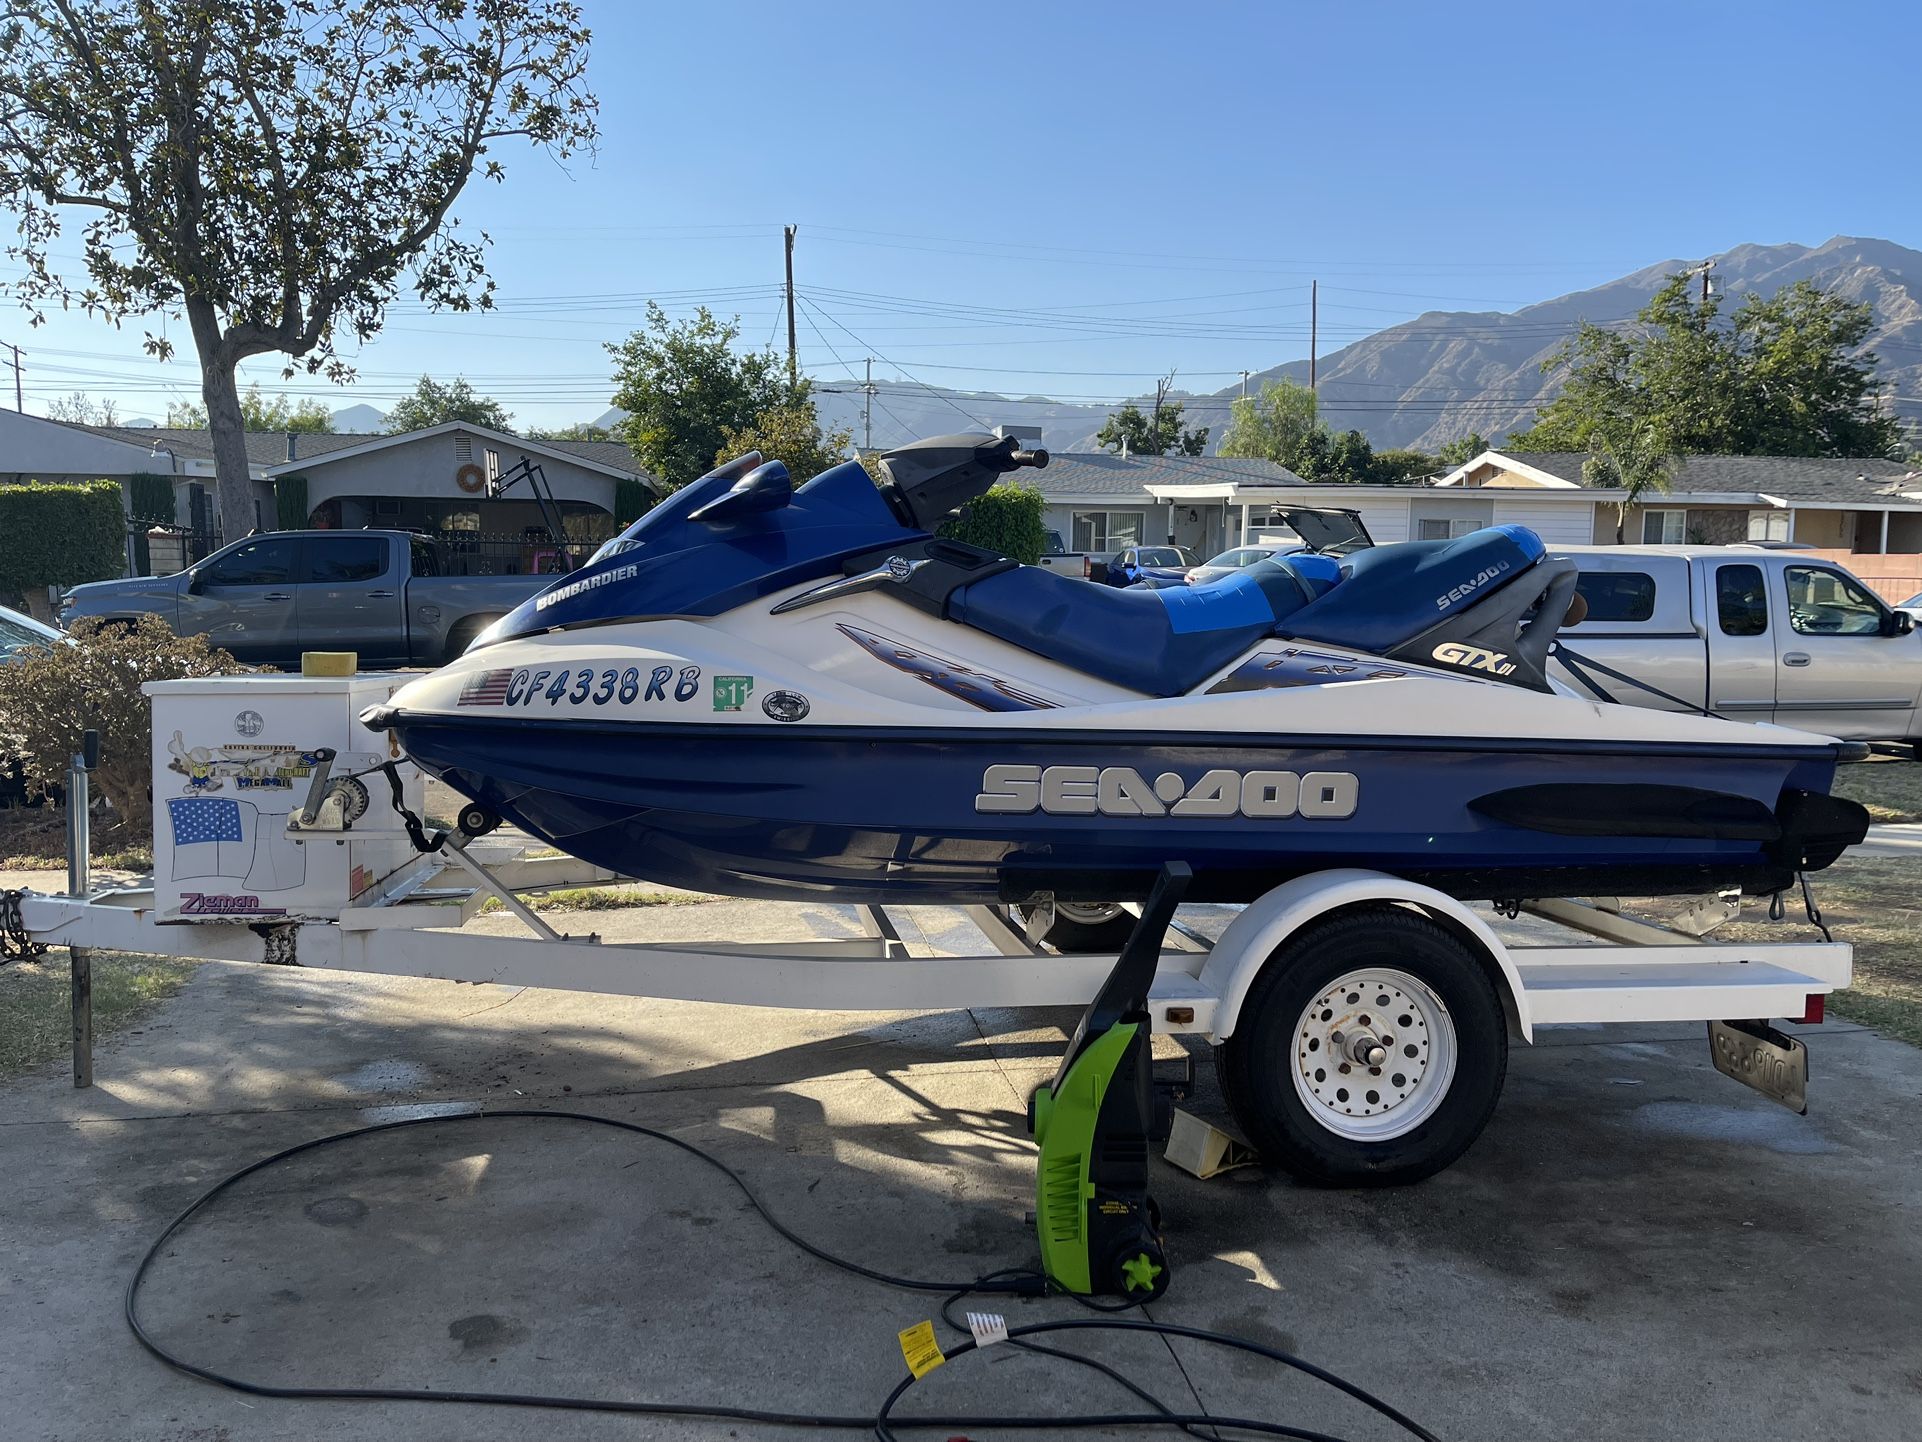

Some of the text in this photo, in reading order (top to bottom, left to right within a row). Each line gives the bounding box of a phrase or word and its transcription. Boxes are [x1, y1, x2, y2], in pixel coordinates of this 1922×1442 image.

[536, 565, 639, 612] BOMBARDIER
[1432, 642, 1508, 673] GTX
[180, 893, 259, 914] Zieman
